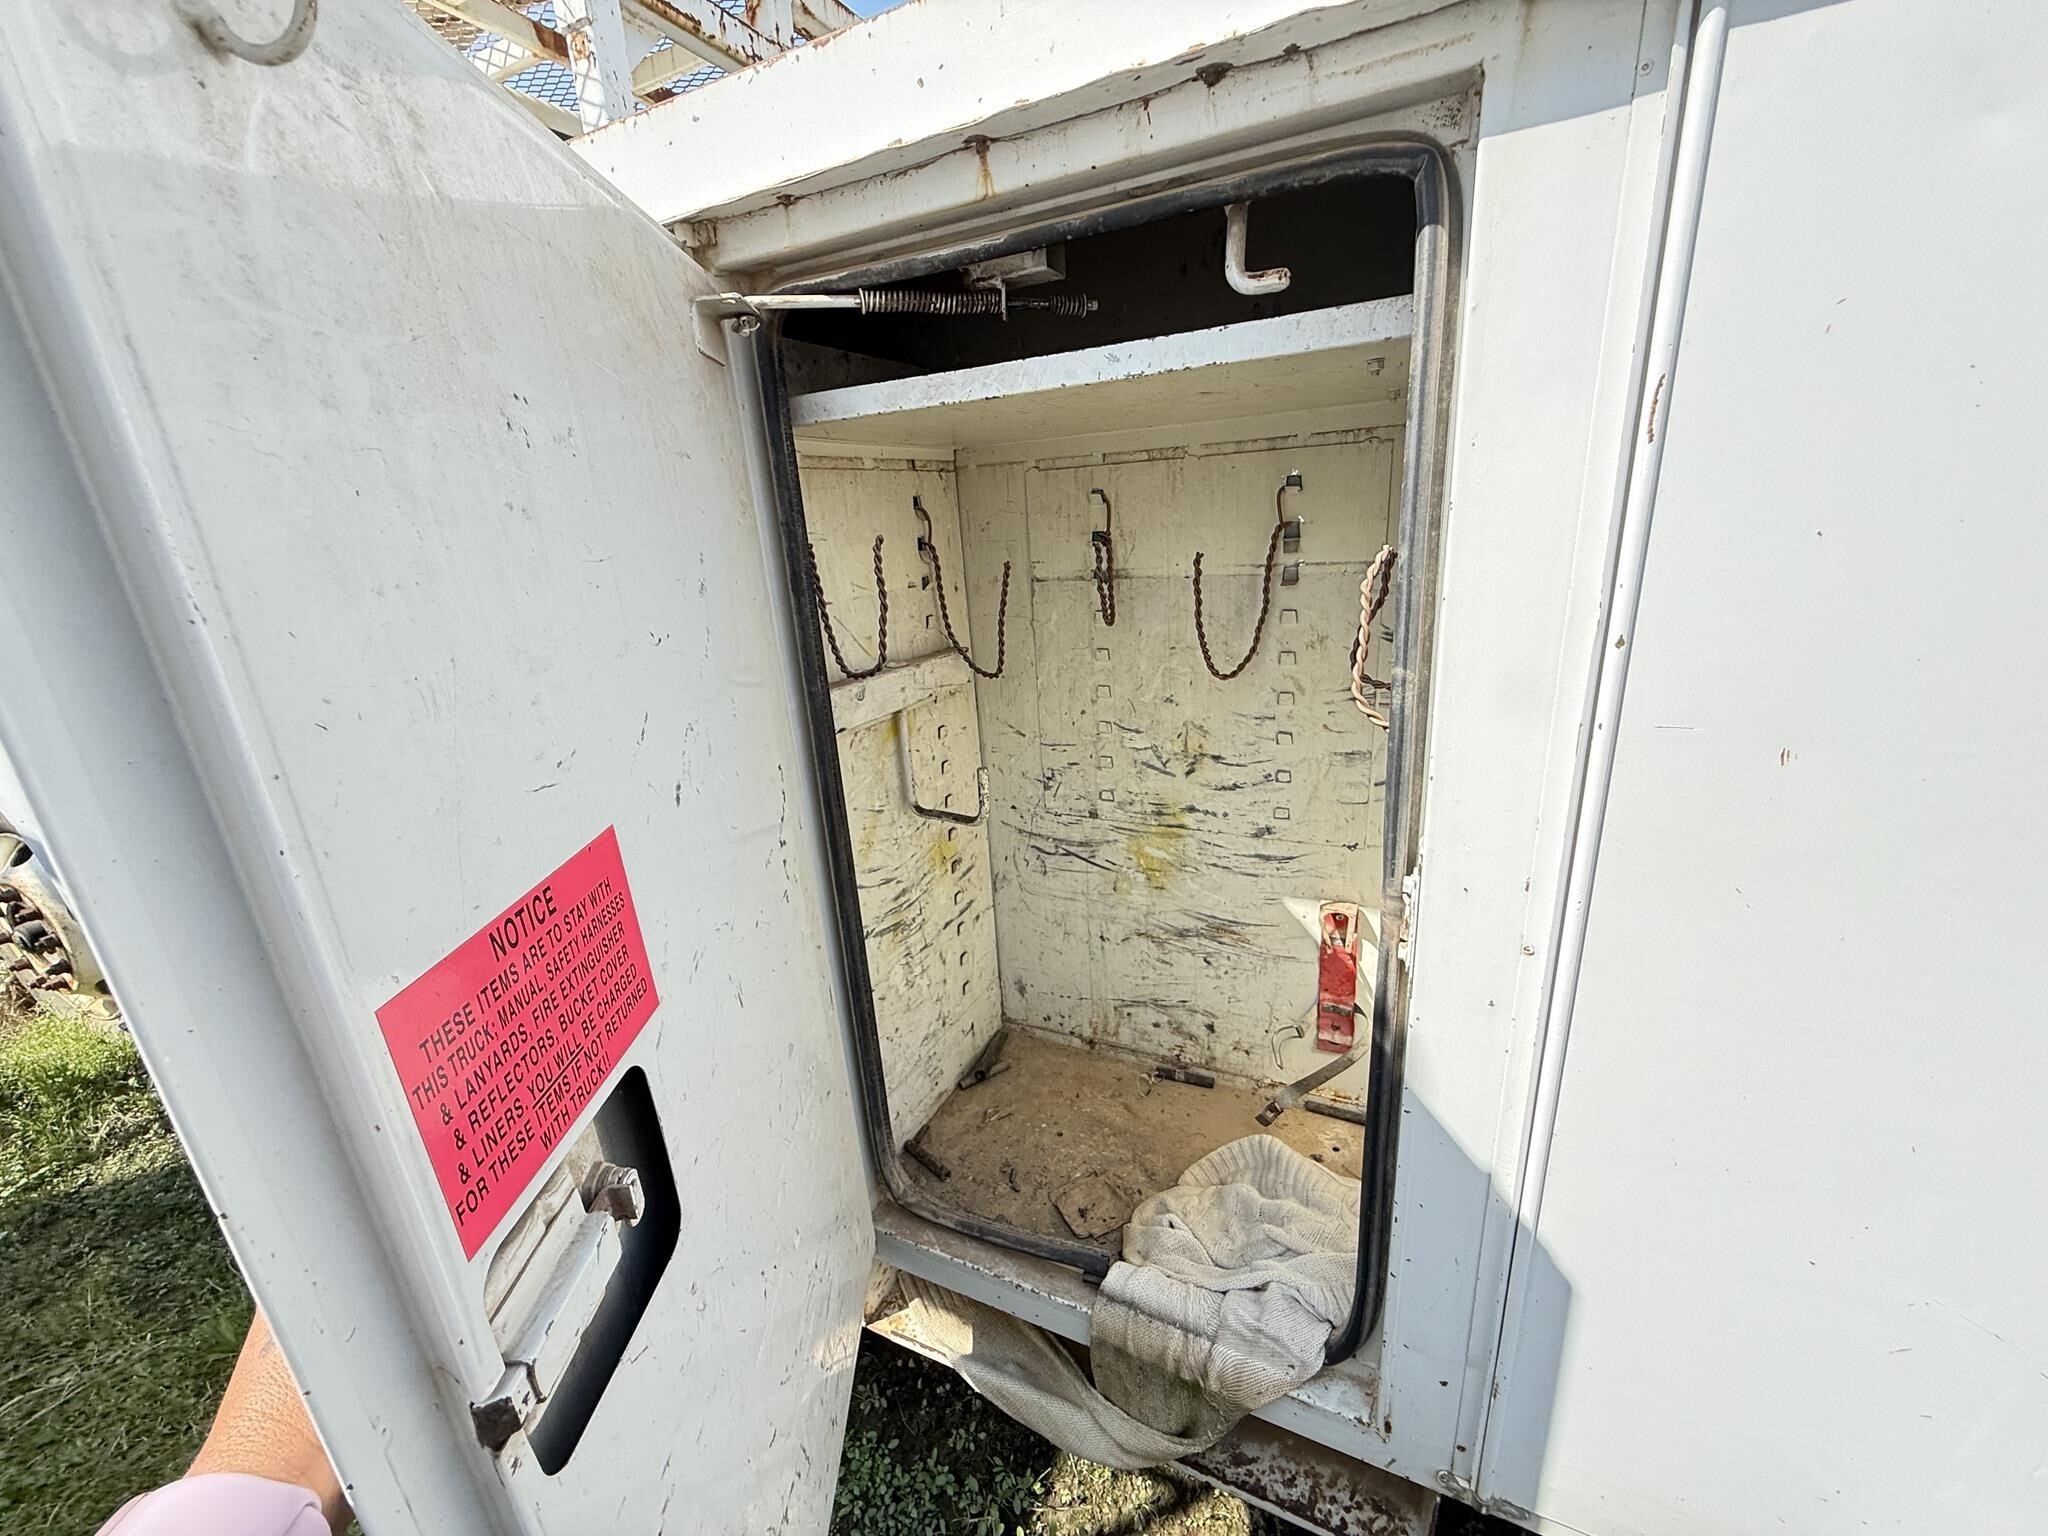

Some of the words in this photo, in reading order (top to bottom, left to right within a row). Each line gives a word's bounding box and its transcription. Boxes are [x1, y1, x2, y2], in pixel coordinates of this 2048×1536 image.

[412, 1065, 448, 1110] THIS
[447, 1020, 498, 1076] TRUCK;
[497, 975, 547, 1030] MANUAL,
[545, 935, 580, 982] SAFETY
[580, 891, 625, 947] HARNESSES
[419, 1002, 476, 1063] THESE
[476, 962, 519, 1014] ITEMS
[522, 936, 547, 974] ARE
[545, 923, 562, 948] TO
[563, 898, 587, 933] STAY
[588, 877, 612, 909] WITH
[440, 1103, 454, 1126] &
[454, 1023, 533, 1110] LANYARDS,
[532, 989, 559, 1029] FIRE
[559, 920, 625, 1000] EXTINGUISHER
[488, 885, 557, 962] NOTICE
[454, 1128, 468, 1151] &
[468, 1028, 559, 1135] REFLECTORS,
[558, 976, 598, 1034] BUCKET
[600, 944, 629, 986] COVER
[455, 1176, 490, 1227] FOR
[488, 1119, 535, 1183] THESE
[535, 1074, 571, 1128] ITEMS
[571, 1058, 582, 1083] IF
[583, 1031, 603, 1067] NOT
[604, 977, 647, 1040] RETURNED
[458, 1162, 472, 1185] &
[472, 1097, 528, 1168] LINERS.
[526, 1062, 553, 1101] YOU
[553, 1033, 581, 1071] WILL
[581, 1011, 597, 1039] BE
[597, 963, 637, 1020] CHARGED
[540, 1104, 571, 1151] WITH
[569, 1051, 612, 1111] TRUCK!!
